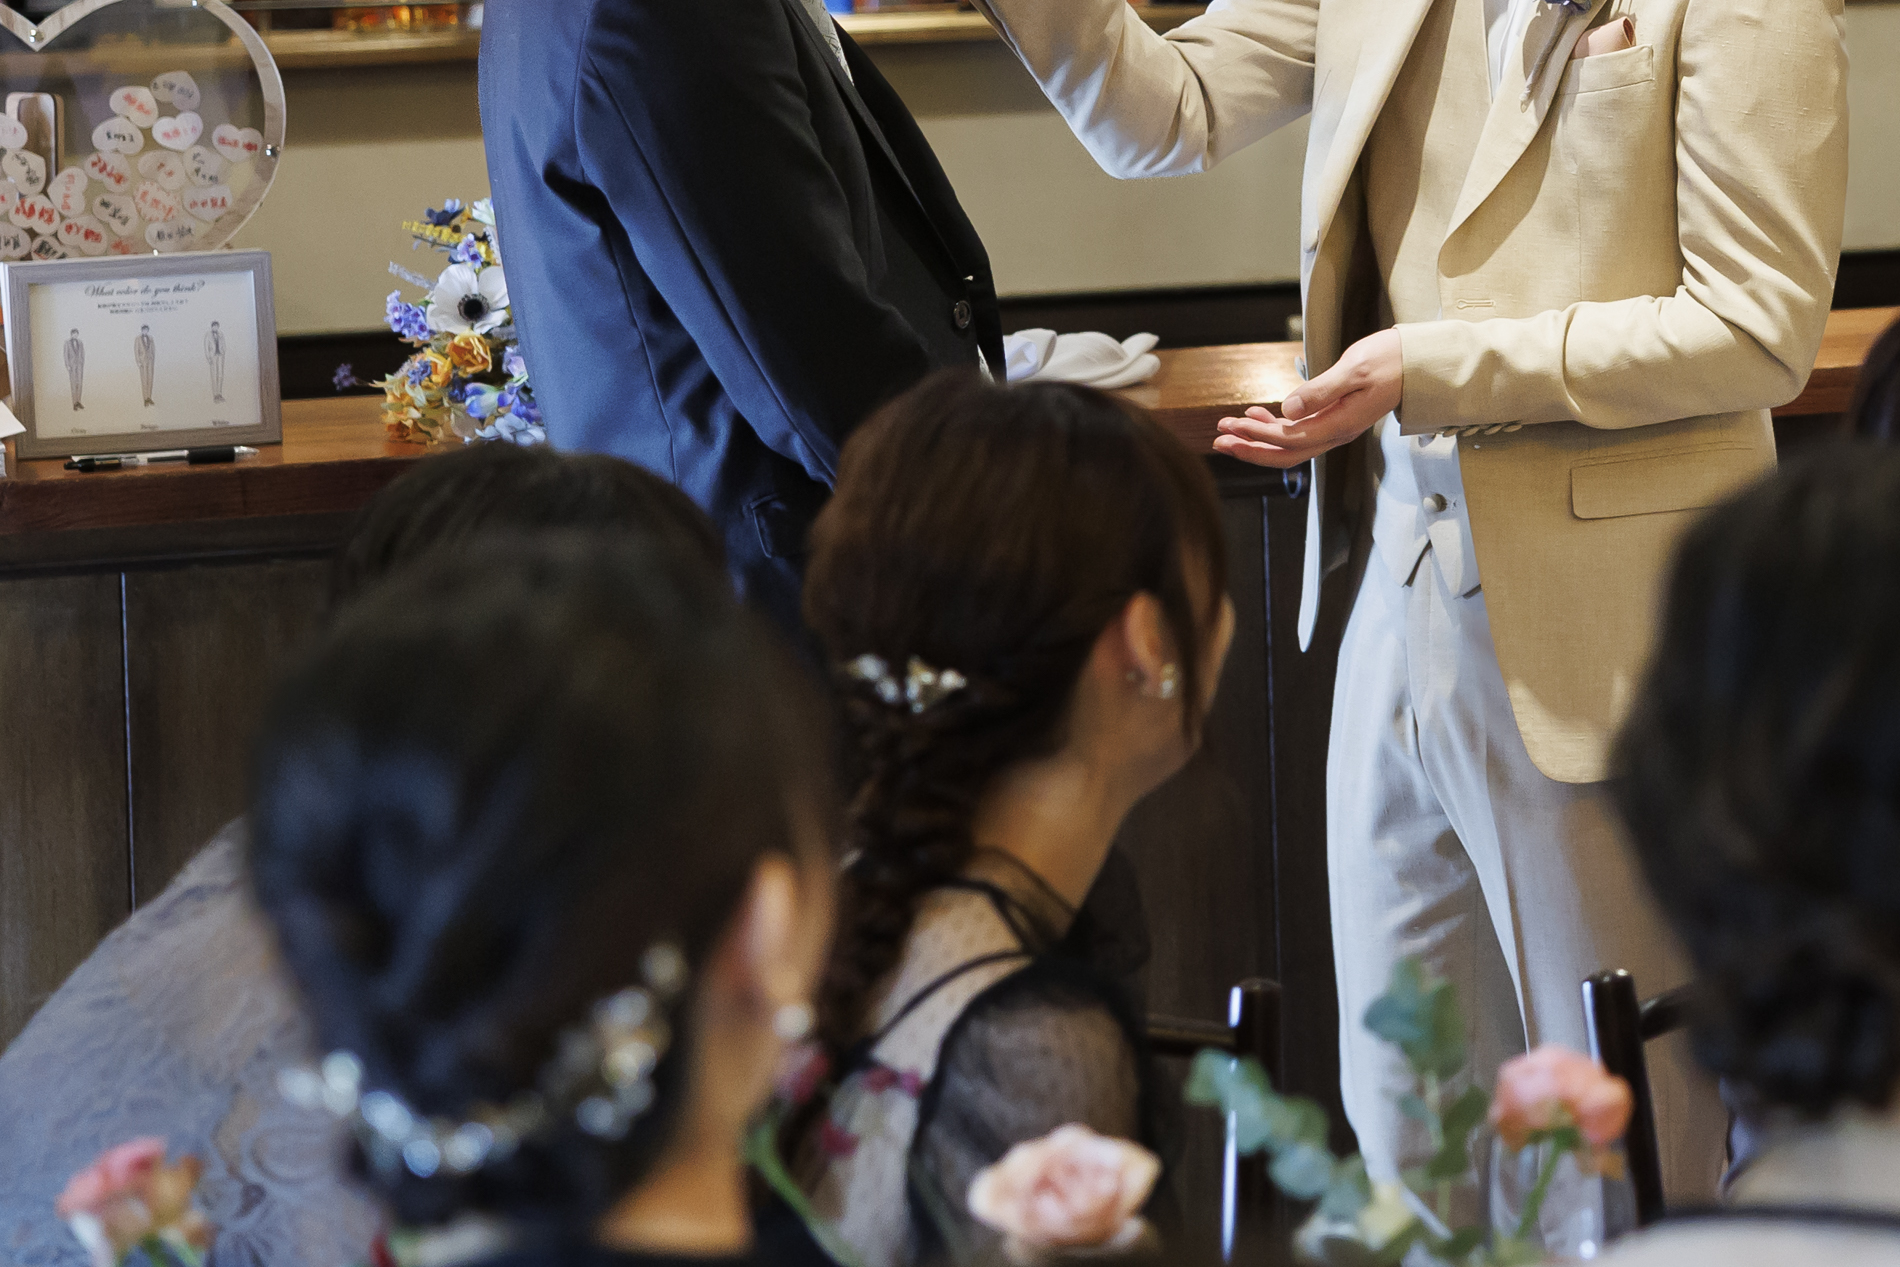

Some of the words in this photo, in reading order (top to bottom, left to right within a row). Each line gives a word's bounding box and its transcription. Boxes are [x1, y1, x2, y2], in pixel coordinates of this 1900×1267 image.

[84, 283, 115, 297] What
[116, 285, 138, 296] color
[140, 284, 151, 295] do
[153, 286, 171, 298] you
[172, 279, 205, 293] think?
